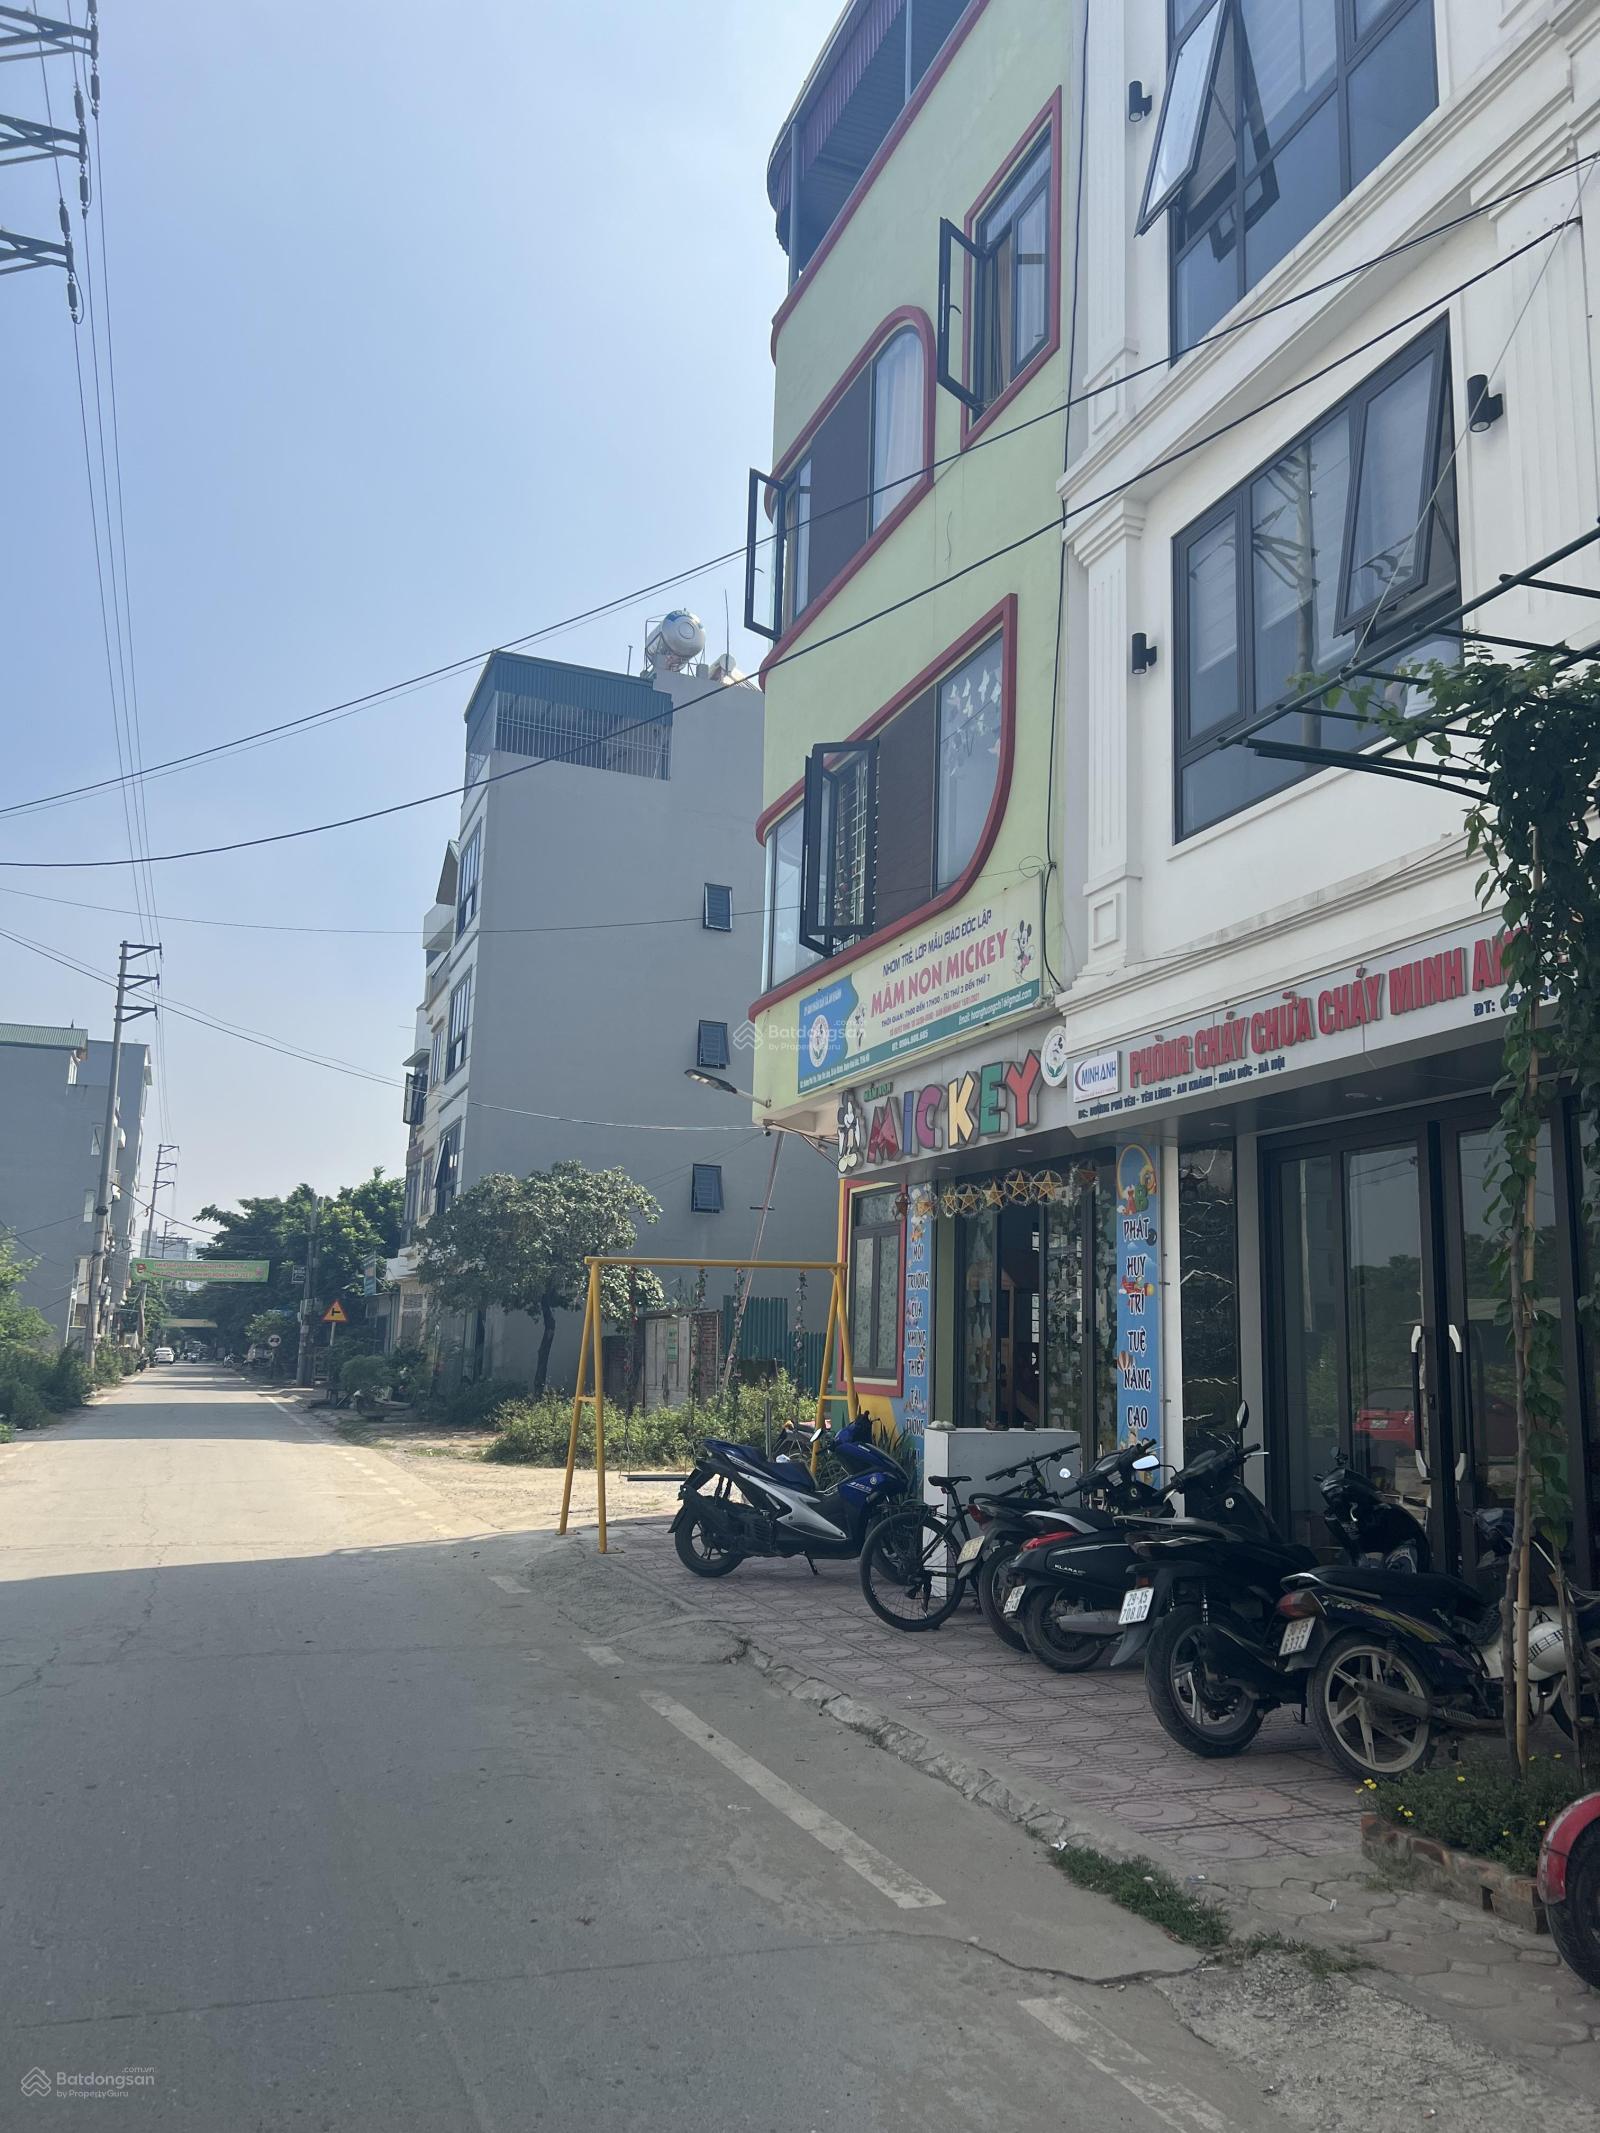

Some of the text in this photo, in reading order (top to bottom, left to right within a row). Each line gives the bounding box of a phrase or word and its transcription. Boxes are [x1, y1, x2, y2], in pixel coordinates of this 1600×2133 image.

[908, 961, 942, 1000] NON
[946, 928, 1008, 983] MICKEY
[1129, 1034, 1193, 1089] PHÒNG
[1194, 1011, 1249, 1070] CHÁY
[1251, 991, 1316, 1054] CHỮA
[1318, 967, 1384, 1036] CHÁY
[1389, 946, 1467, 1015] MINH
[1472, 924, 1532, 991] AN
[1177, 1083, 1187, 1094] AN
[867, 1049, 1041, 1164] MICKEY
[1123, 1214, 1150, 1242] PHÁT
[1126, 1254, 1147, 1277] HUY
[1128, 1288, 1145, 1316] TRÍ
[1127, 1326, 1147, 1357] TUỆ
[1127, 1405, 1149, 1429] CAO
